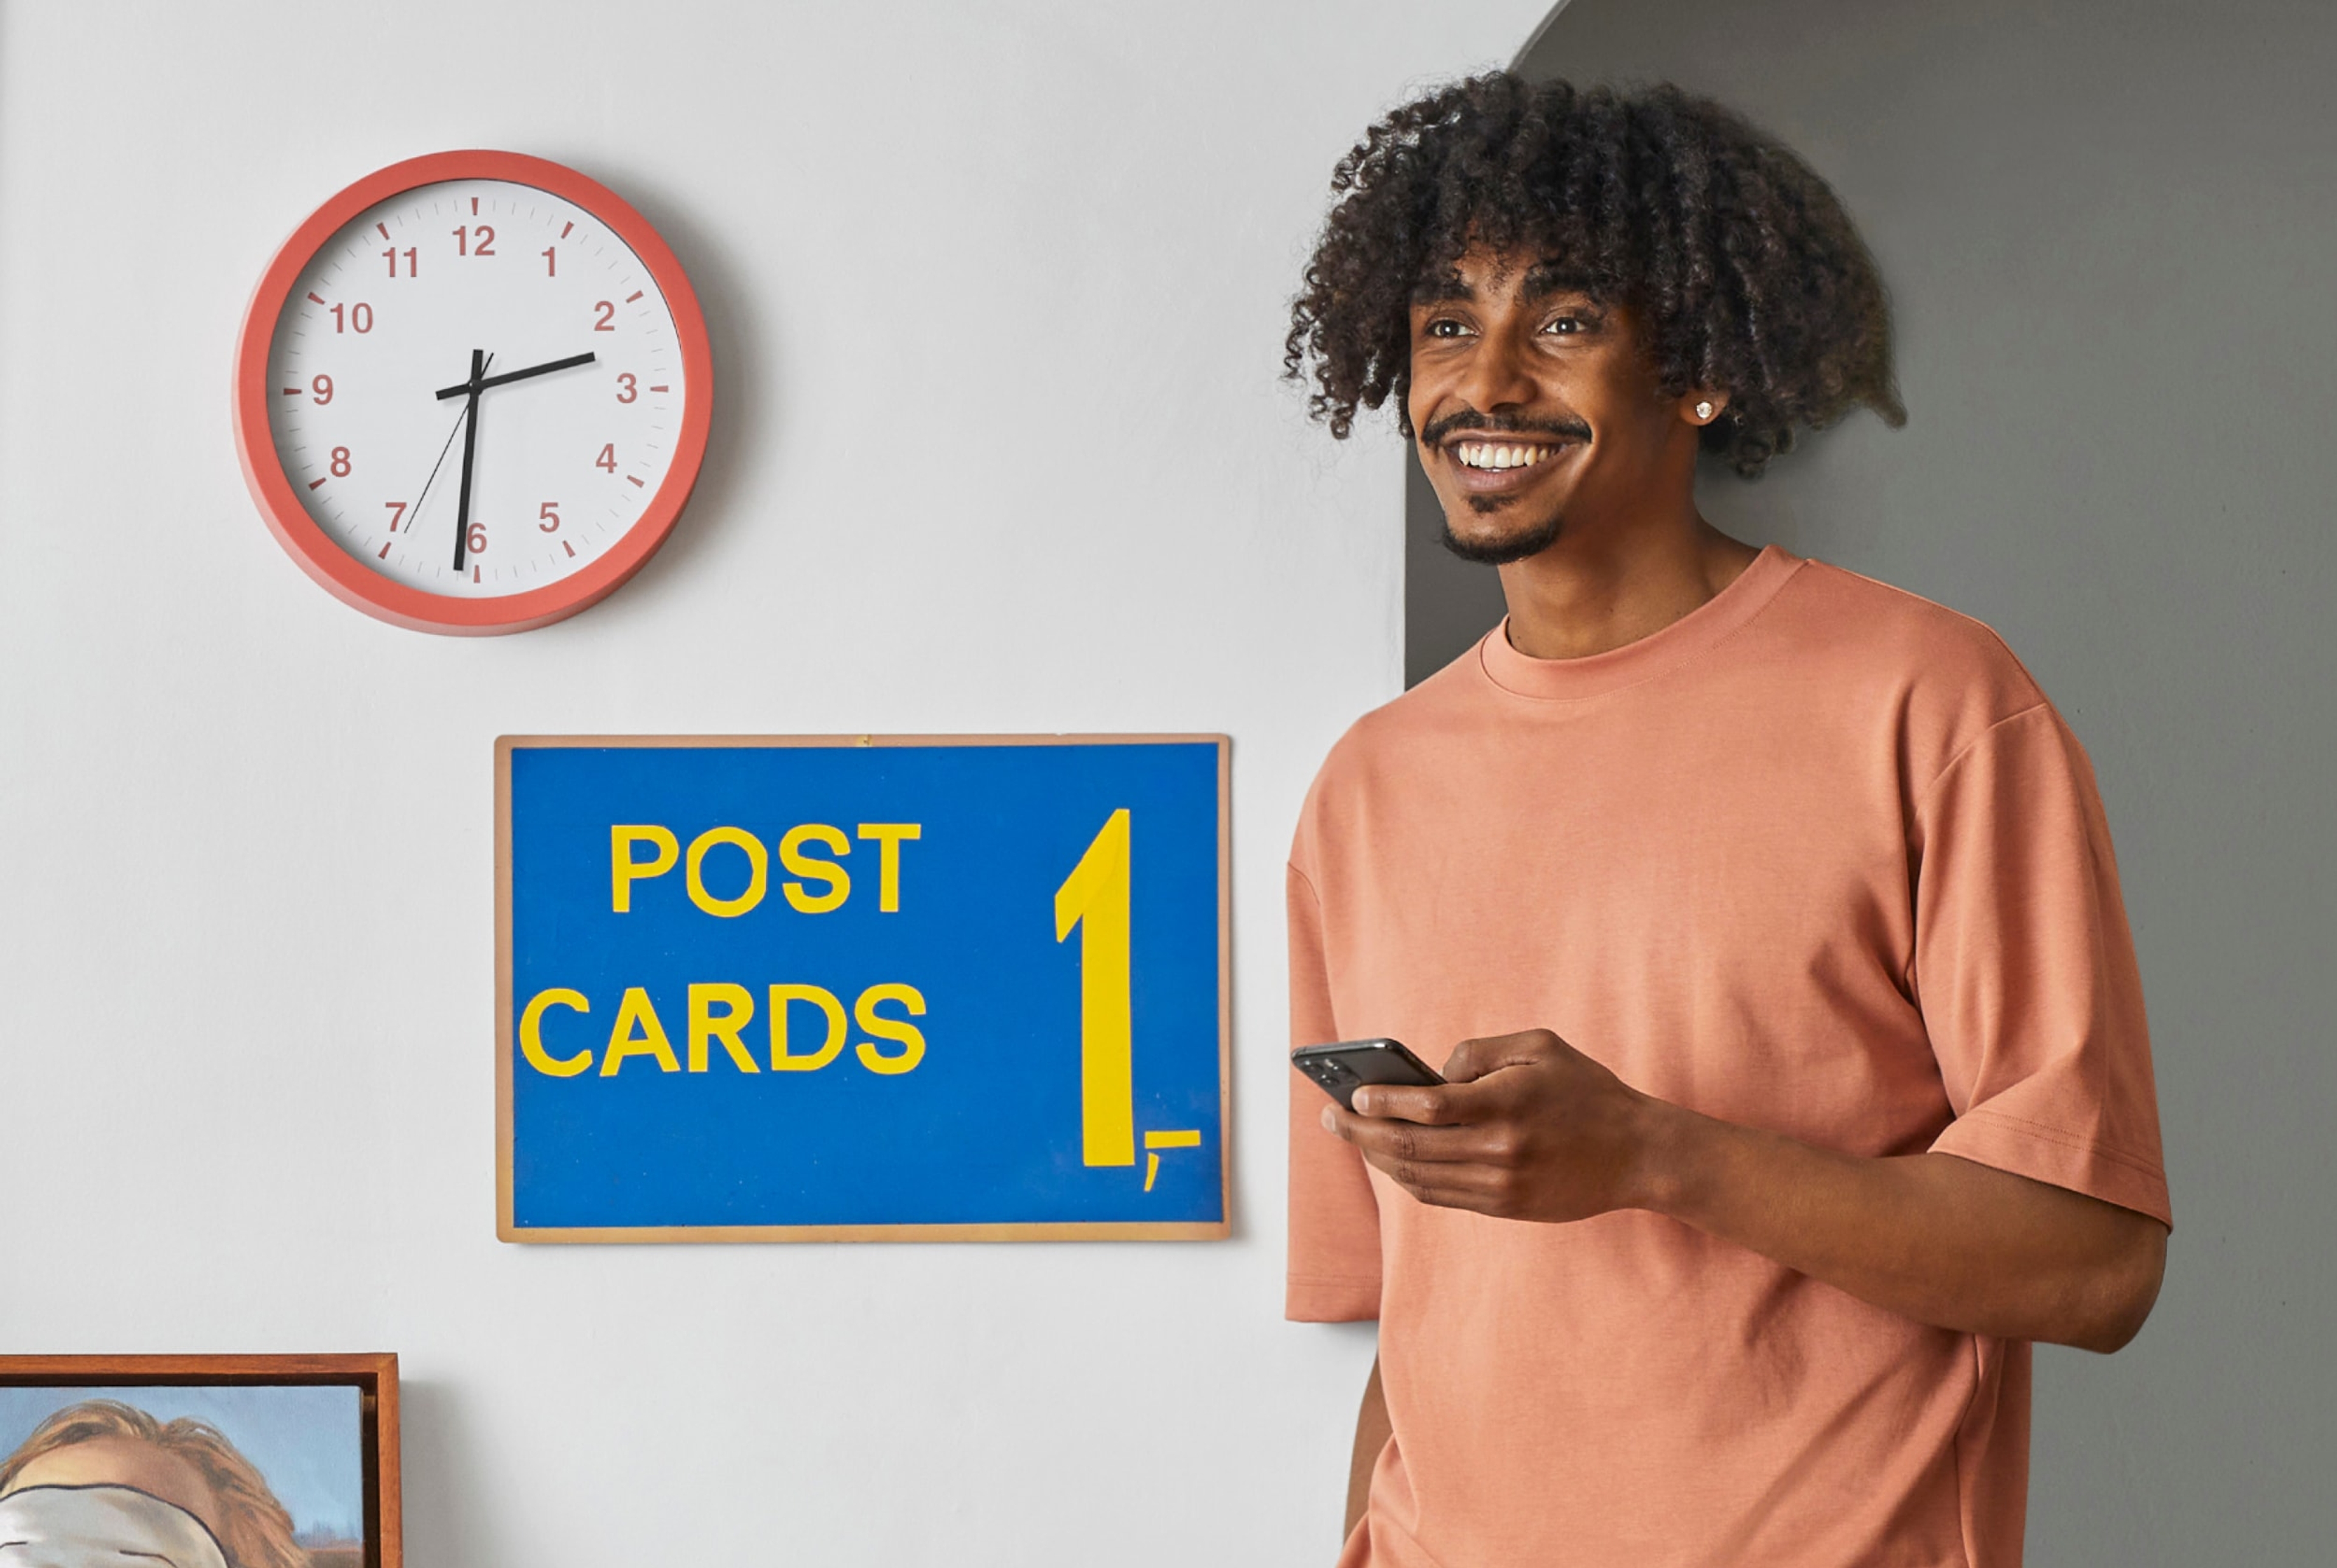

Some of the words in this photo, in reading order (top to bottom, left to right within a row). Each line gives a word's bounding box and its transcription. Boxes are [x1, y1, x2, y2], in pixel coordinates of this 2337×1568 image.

[453, 225, 495, 256] 12
[383, 246, 417, 278] 11
[542, 246, 556, 277] 1
[330, 302, 373, 334] 10
[594, 300, 615, 332] 2
[312, 374, 334, 405] 9
[617, 372, 638, 404] 3
[330, 445, 352, 478] 8
[595, 444, 617, 473] 4
[385, 501, 407, 532] 7
[539, 501, 560, 533] 5
[466, 522, 487, 554] 6
[611, 823, 921, 918] POST
[519, 983, 926, 1077] CARDS
